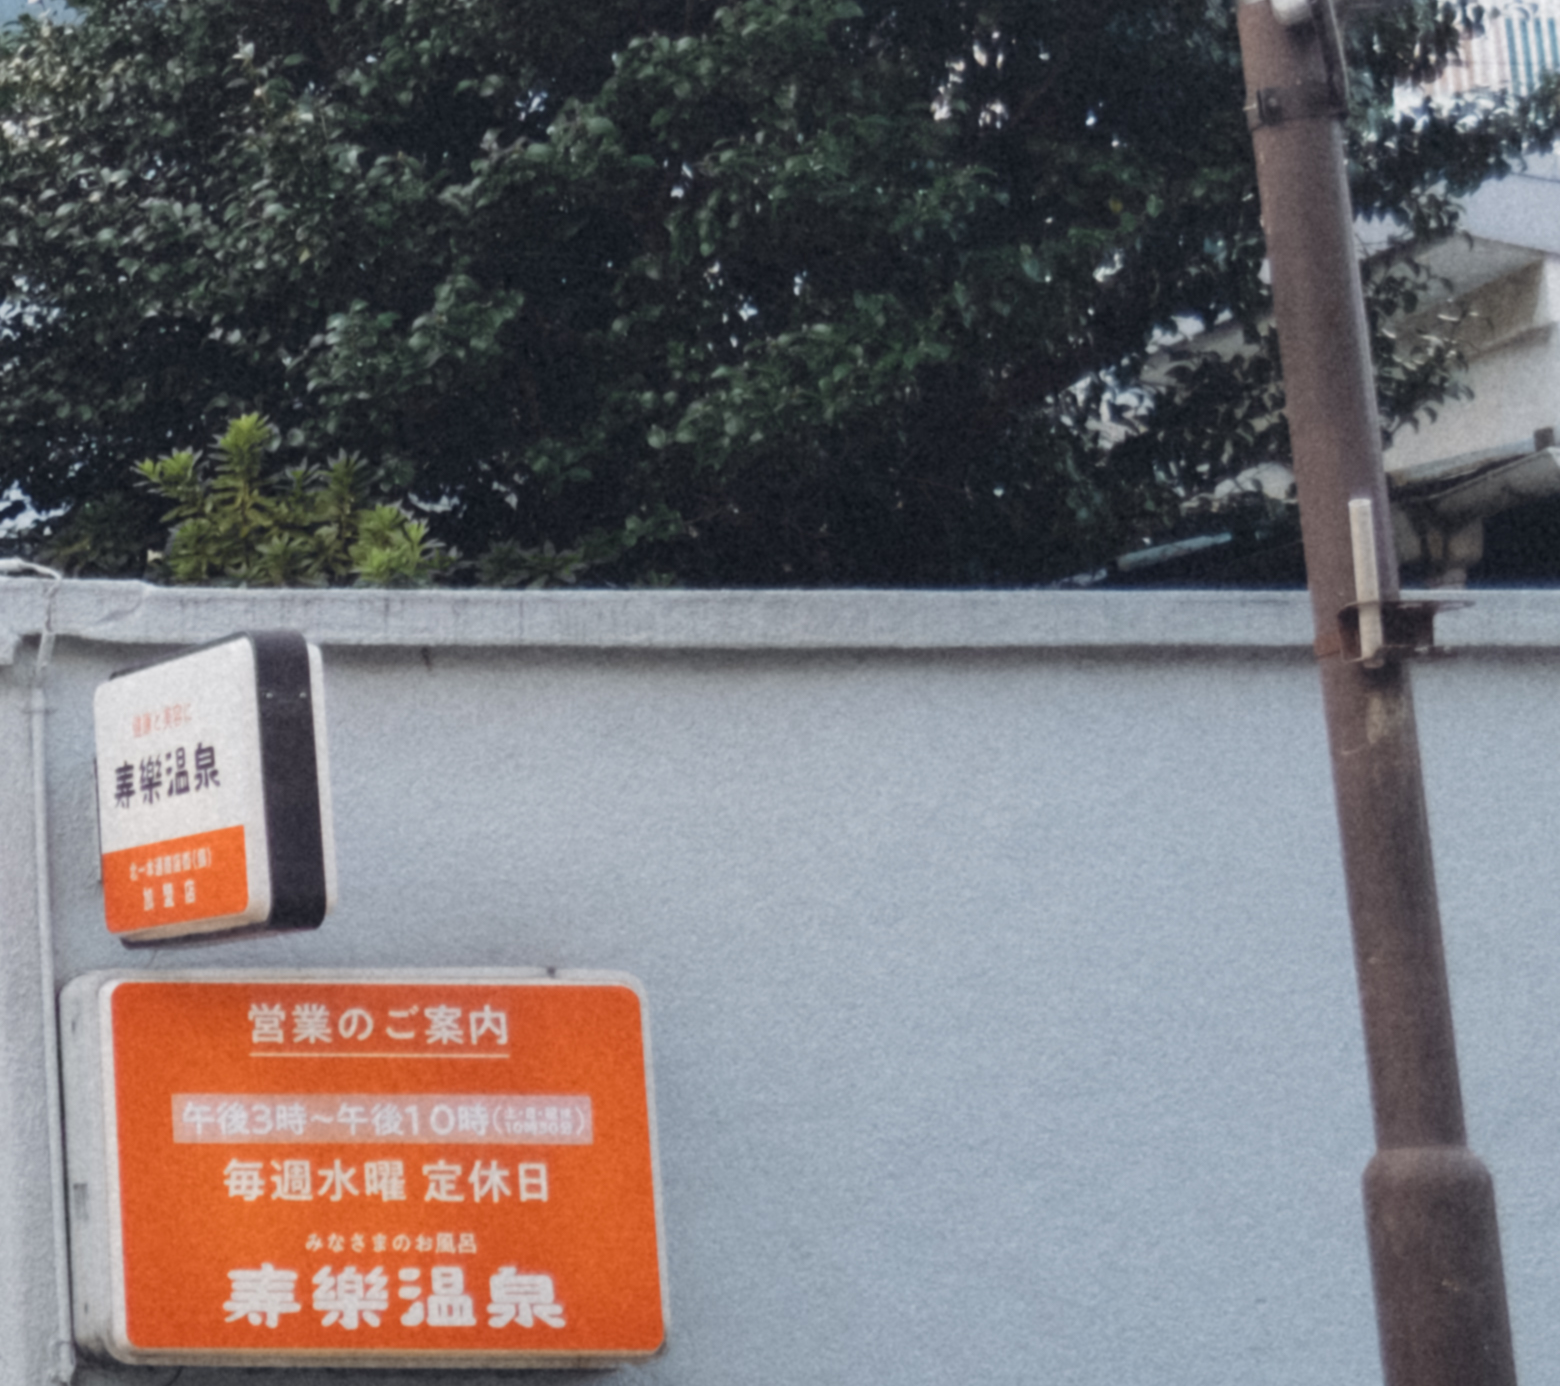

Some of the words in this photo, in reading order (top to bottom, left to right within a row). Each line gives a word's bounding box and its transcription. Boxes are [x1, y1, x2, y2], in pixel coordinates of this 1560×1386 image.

[248, 1003, 510, 1046] 営業のご案内
[223, 1159, 407, 1203] 毎週水曜
[423, 1161, 549, 1203] 定休日
[305, 1231, 478, 1256] みなさまのお風呂
